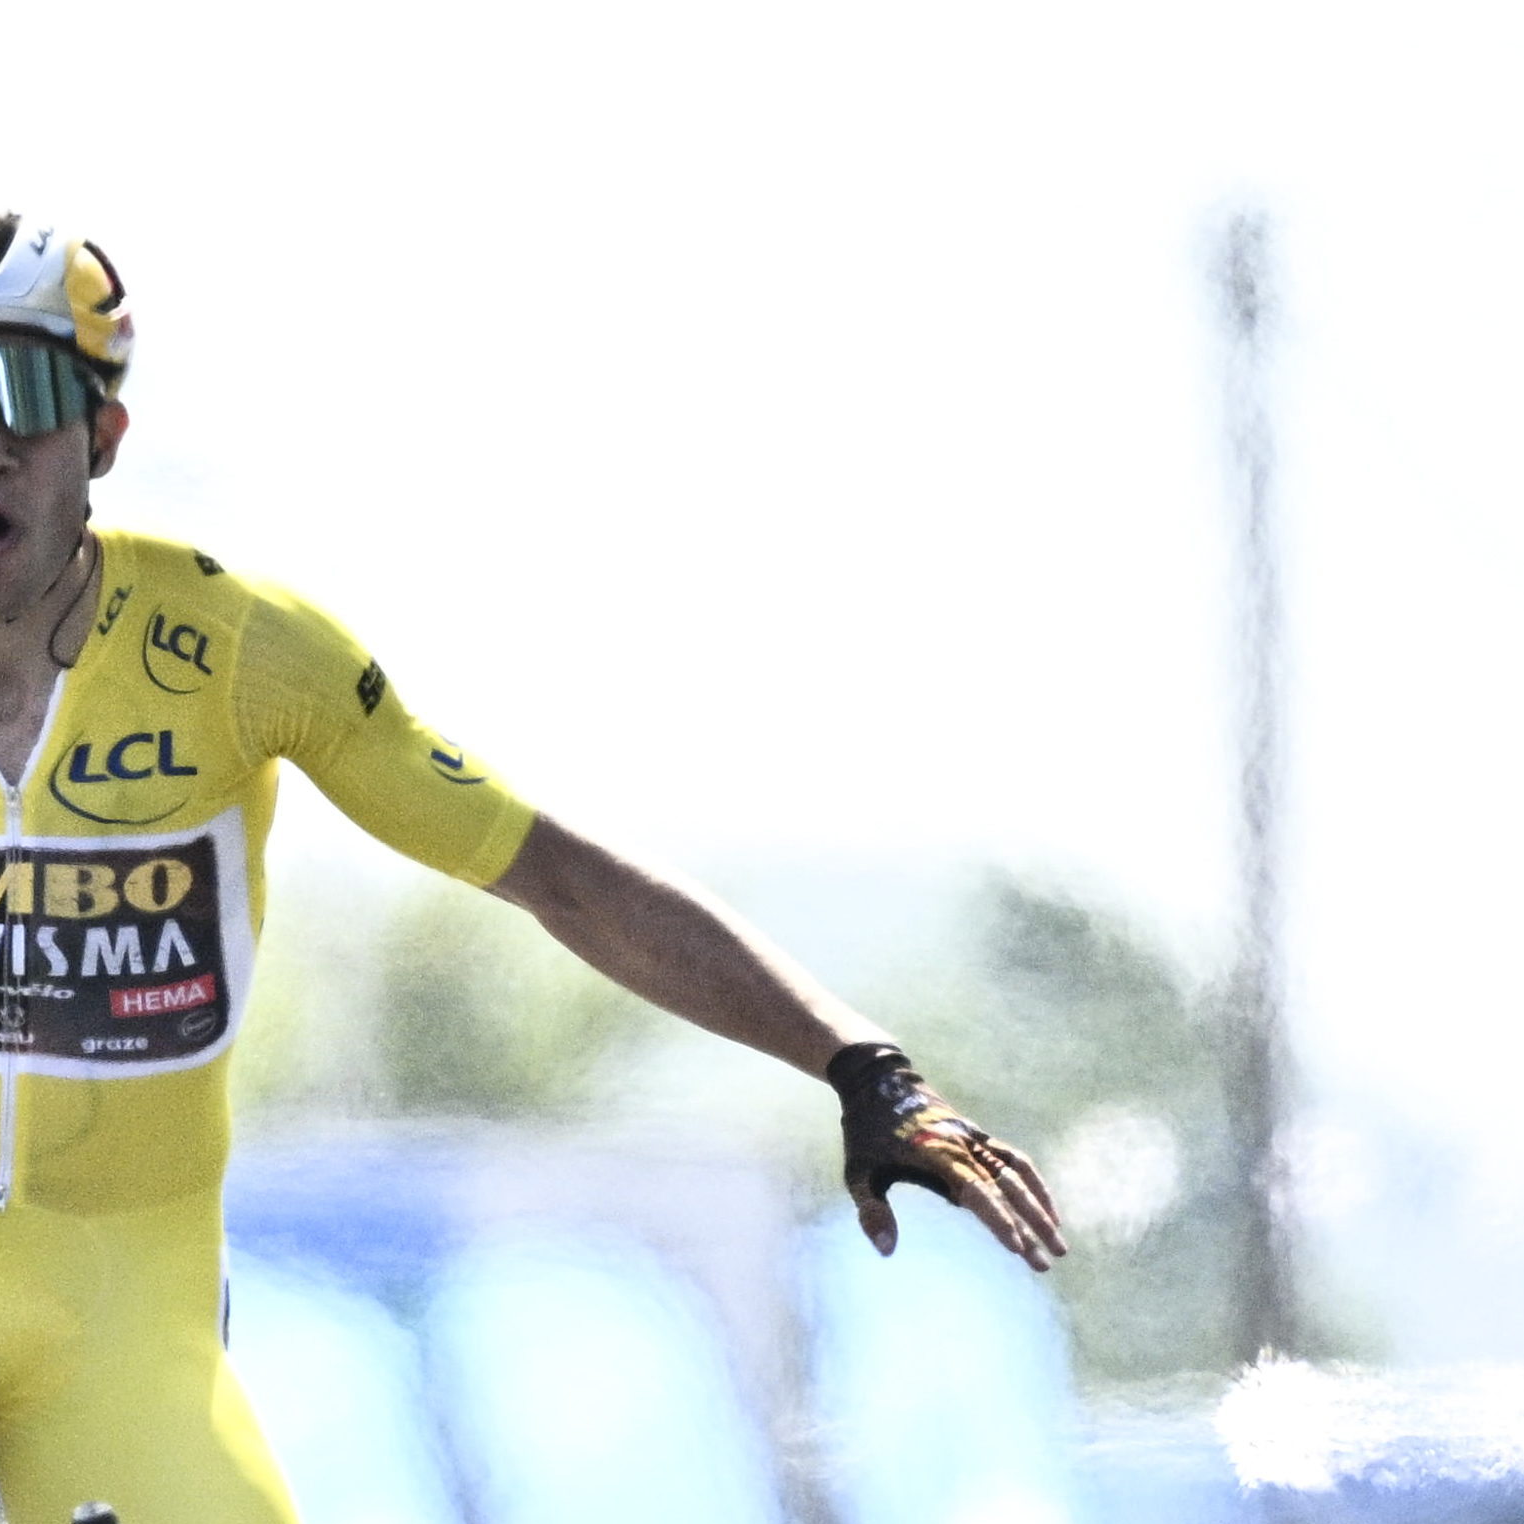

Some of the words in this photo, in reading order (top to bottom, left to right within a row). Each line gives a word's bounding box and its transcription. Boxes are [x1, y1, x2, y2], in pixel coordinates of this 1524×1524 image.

[151, 612, 213, 676] LCL
[67, 729, 199, 784] LCL
[122, 981, 207, 1014] HEMA
[81, 1035, 150, 1055] graze
